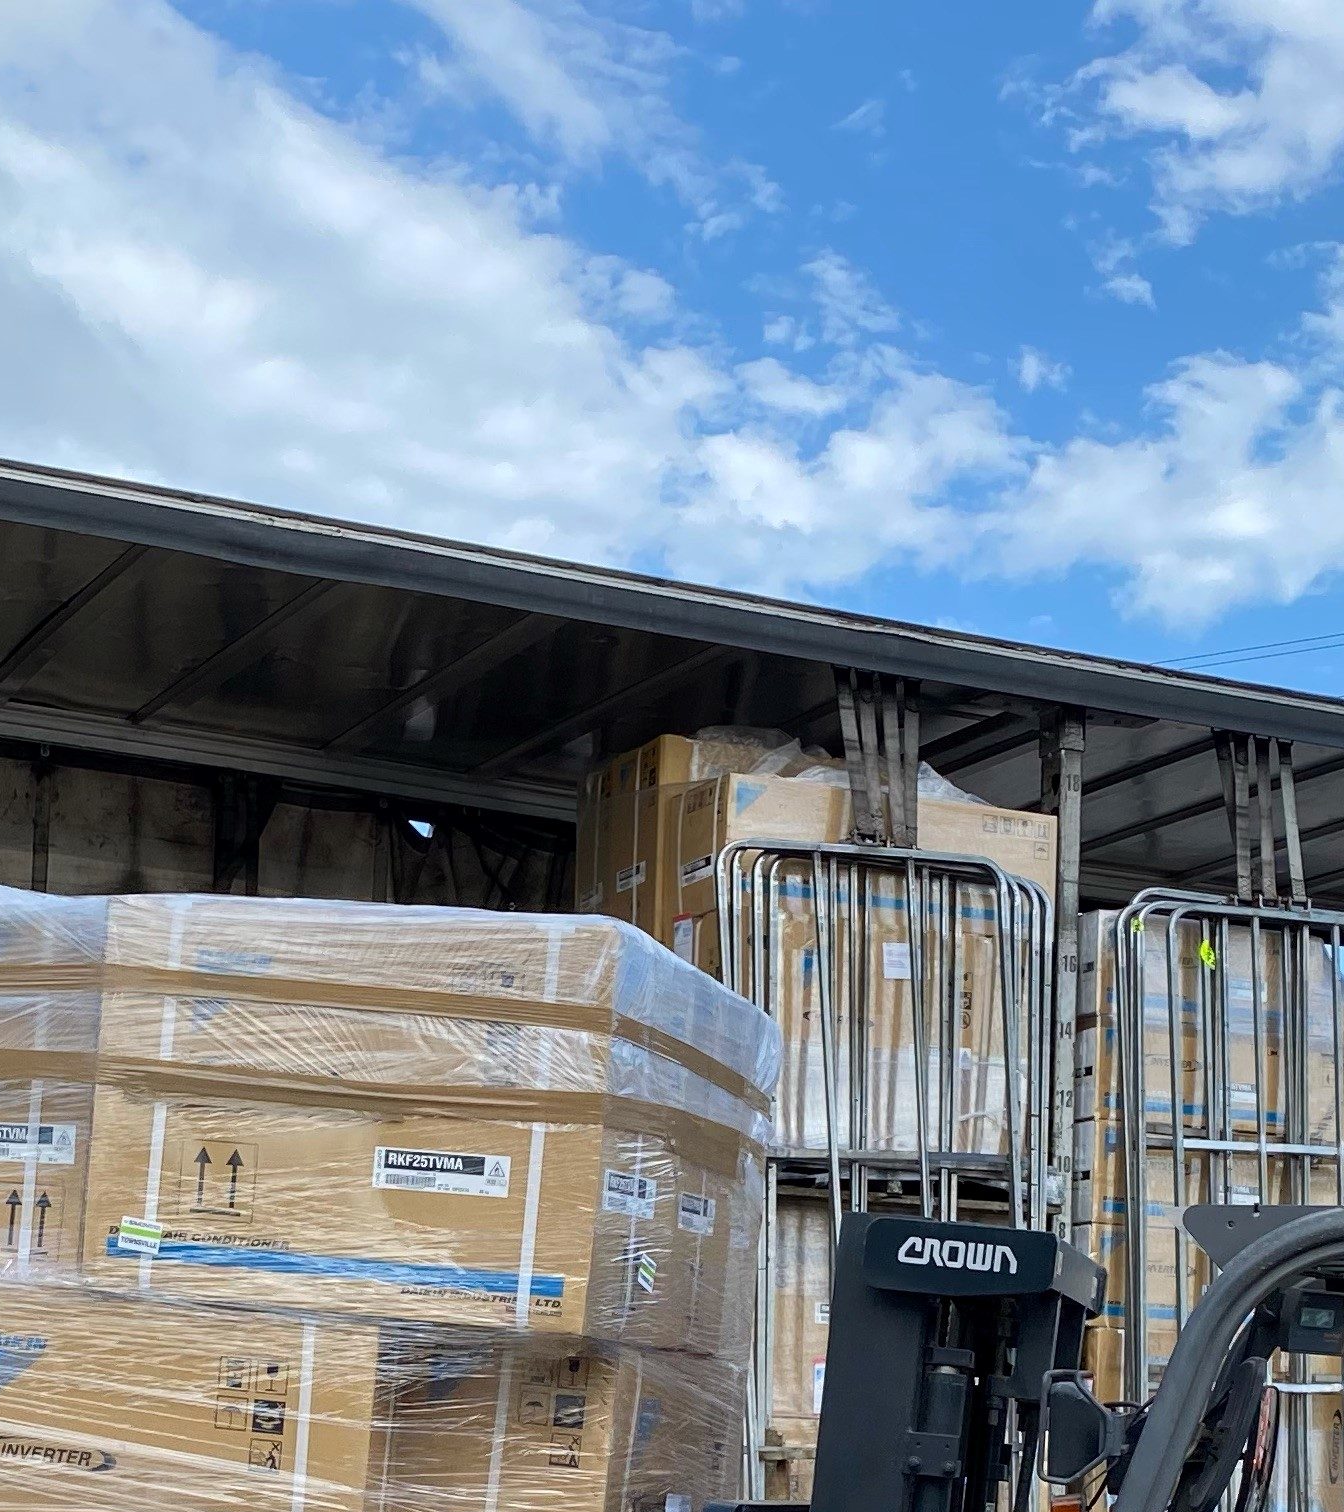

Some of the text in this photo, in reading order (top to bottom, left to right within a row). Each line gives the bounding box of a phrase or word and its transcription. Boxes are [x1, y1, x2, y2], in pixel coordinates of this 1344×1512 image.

[387, 1152, 464, 1172] RKF25TVMA
[897, 1235, 1018, 1276] CROWN
[1, 1442, 93, 1467] INVERTER
